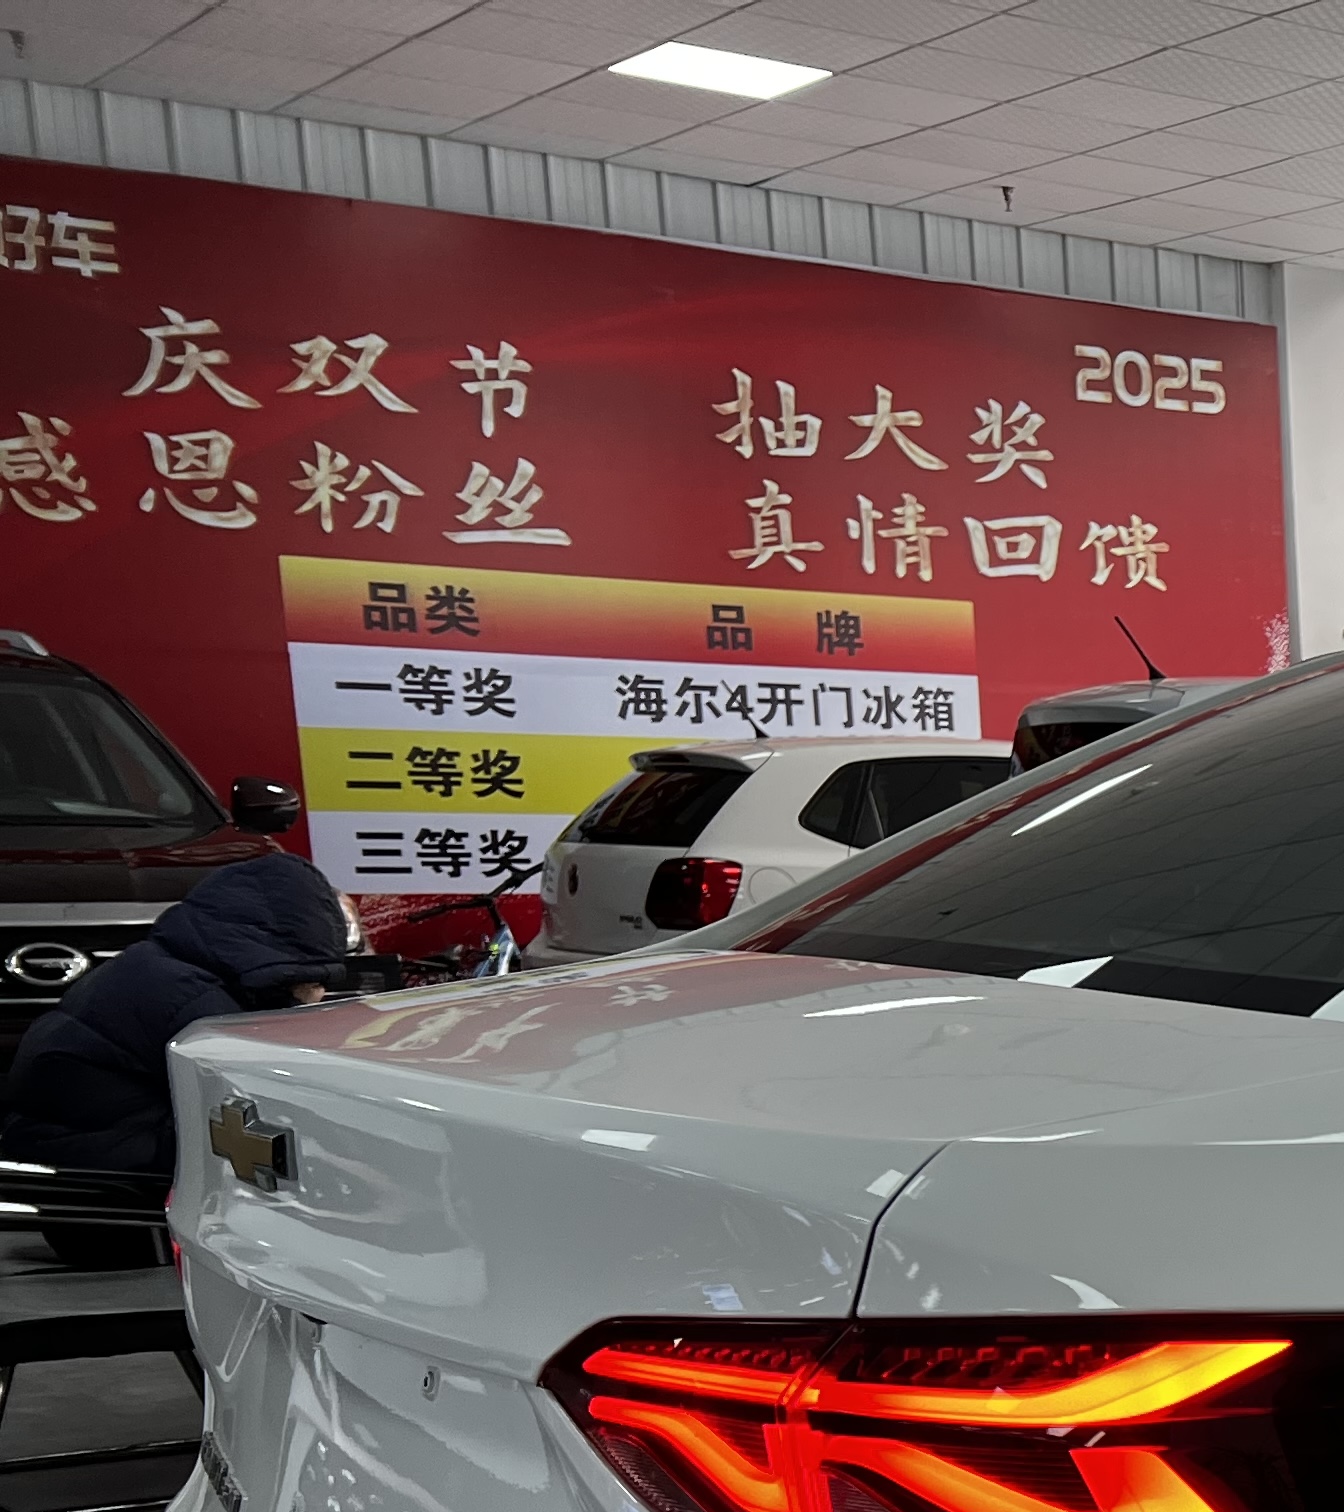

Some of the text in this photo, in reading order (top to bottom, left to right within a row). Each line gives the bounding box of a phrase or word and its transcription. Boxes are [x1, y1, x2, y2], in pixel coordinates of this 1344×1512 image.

[121, 305, 1055, 489] 庆双节 抽大奖
[1074, 344, 1226, 415] 2025
[0, 411, 1171, 592] 感恩粉丝 真情回馈
[361, 582, 481, 637] 品类
[706, 603, 864, 656] 品牌
[334, 663, 518, 718] 一等奖
[615, 674, 956, 733] 海尔4开门冰箱
[345, 746, 526, 799] 二等奖
[354, 828, 533, 876] 三等奖
